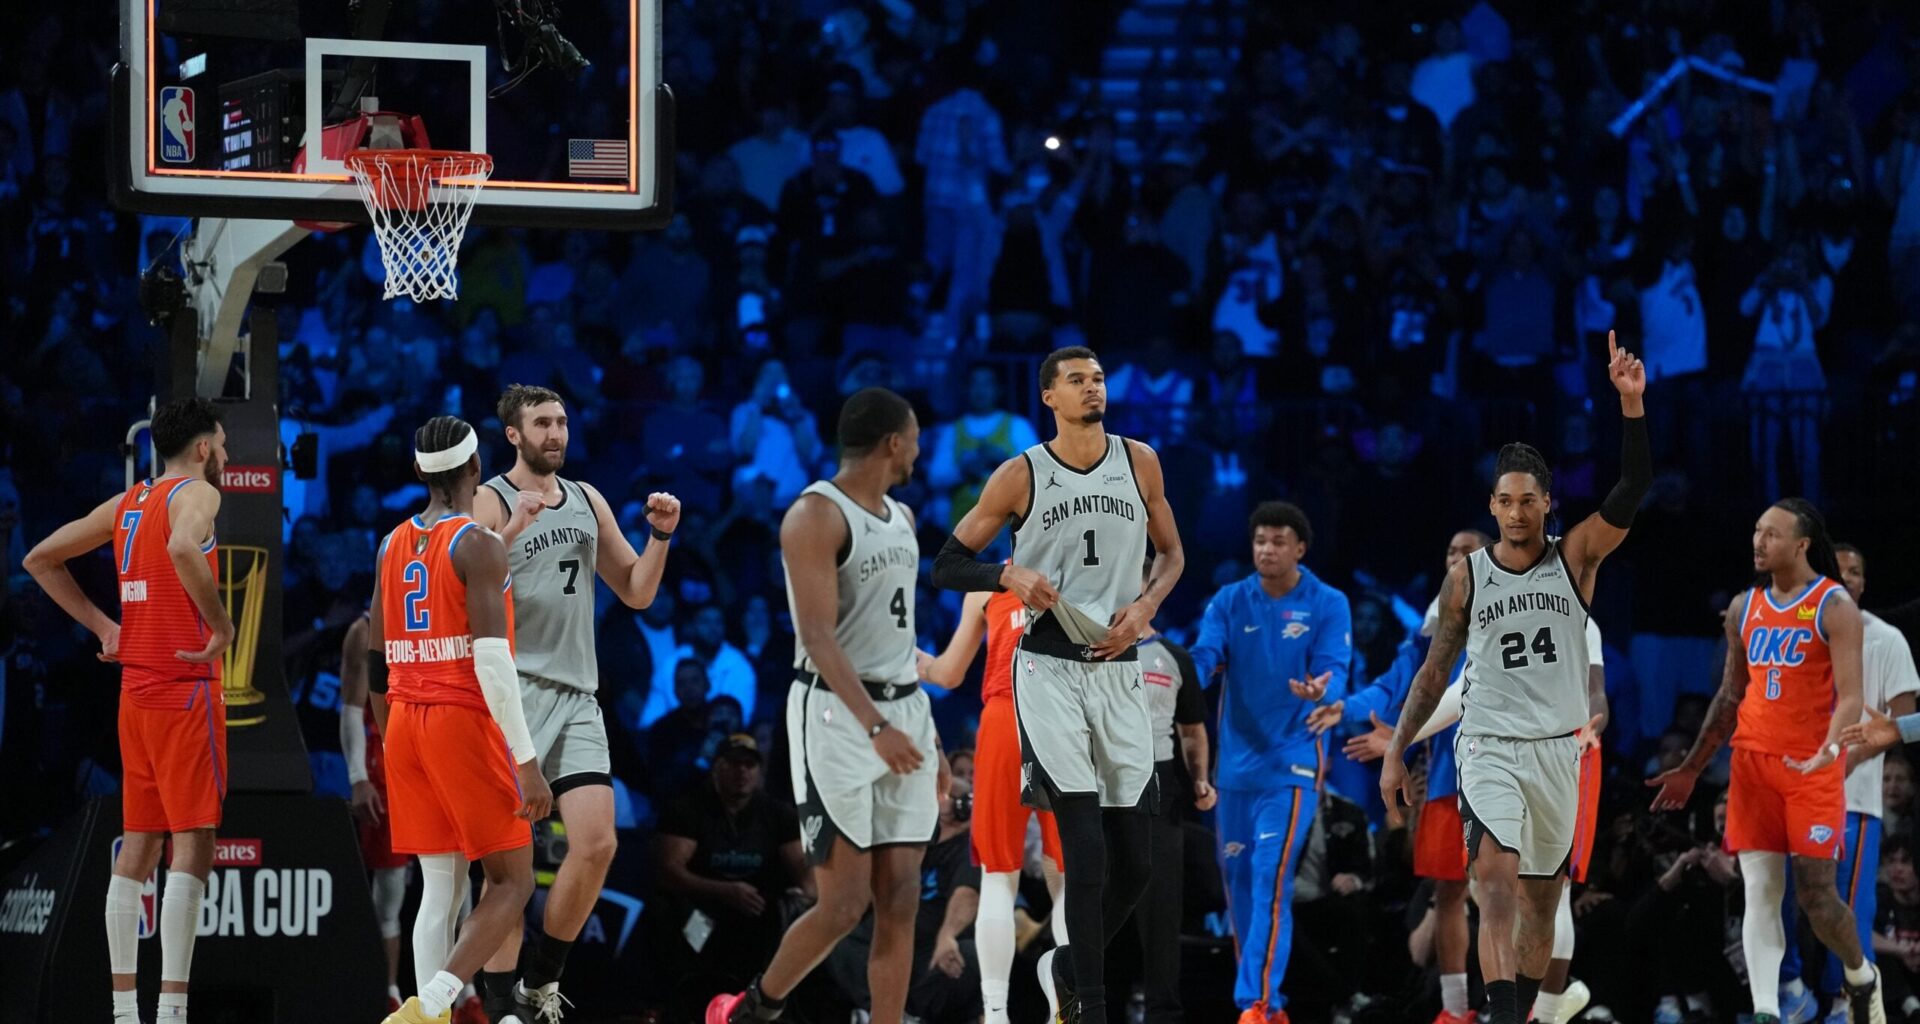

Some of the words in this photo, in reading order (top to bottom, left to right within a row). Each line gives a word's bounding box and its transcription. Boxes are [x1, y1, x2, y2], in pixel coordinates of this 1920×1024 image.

[166, 145, 182, 157] NBA
[1042, 500, 1069, 531] SAN
[1073, 495, 1135, 522] ANTONIO
[121, 510, 143, 574] 7
[524, 532, 550, 560] SAN
[1082, 529, 1100, 567] 1
[558, 559, 580, 595] 7
[860, 550, 888, 582] SAN
[403, 560, 430, 632] 2
[889, 587, 907, 629] 4
[1478, 599, 1505, 630] SAN
[1508, 592, 1570, 616] ANTONIO
[384, 634, 474, 664] EOUS-ALEXANDE
[1500, 626, 1558, 670] 24
[1748, 625, 1813, 667] OKC
[1766, 667, 1781, 700] 6
[196, 868, 246, 937] BA
[253, 868, 333, 937] CUP
